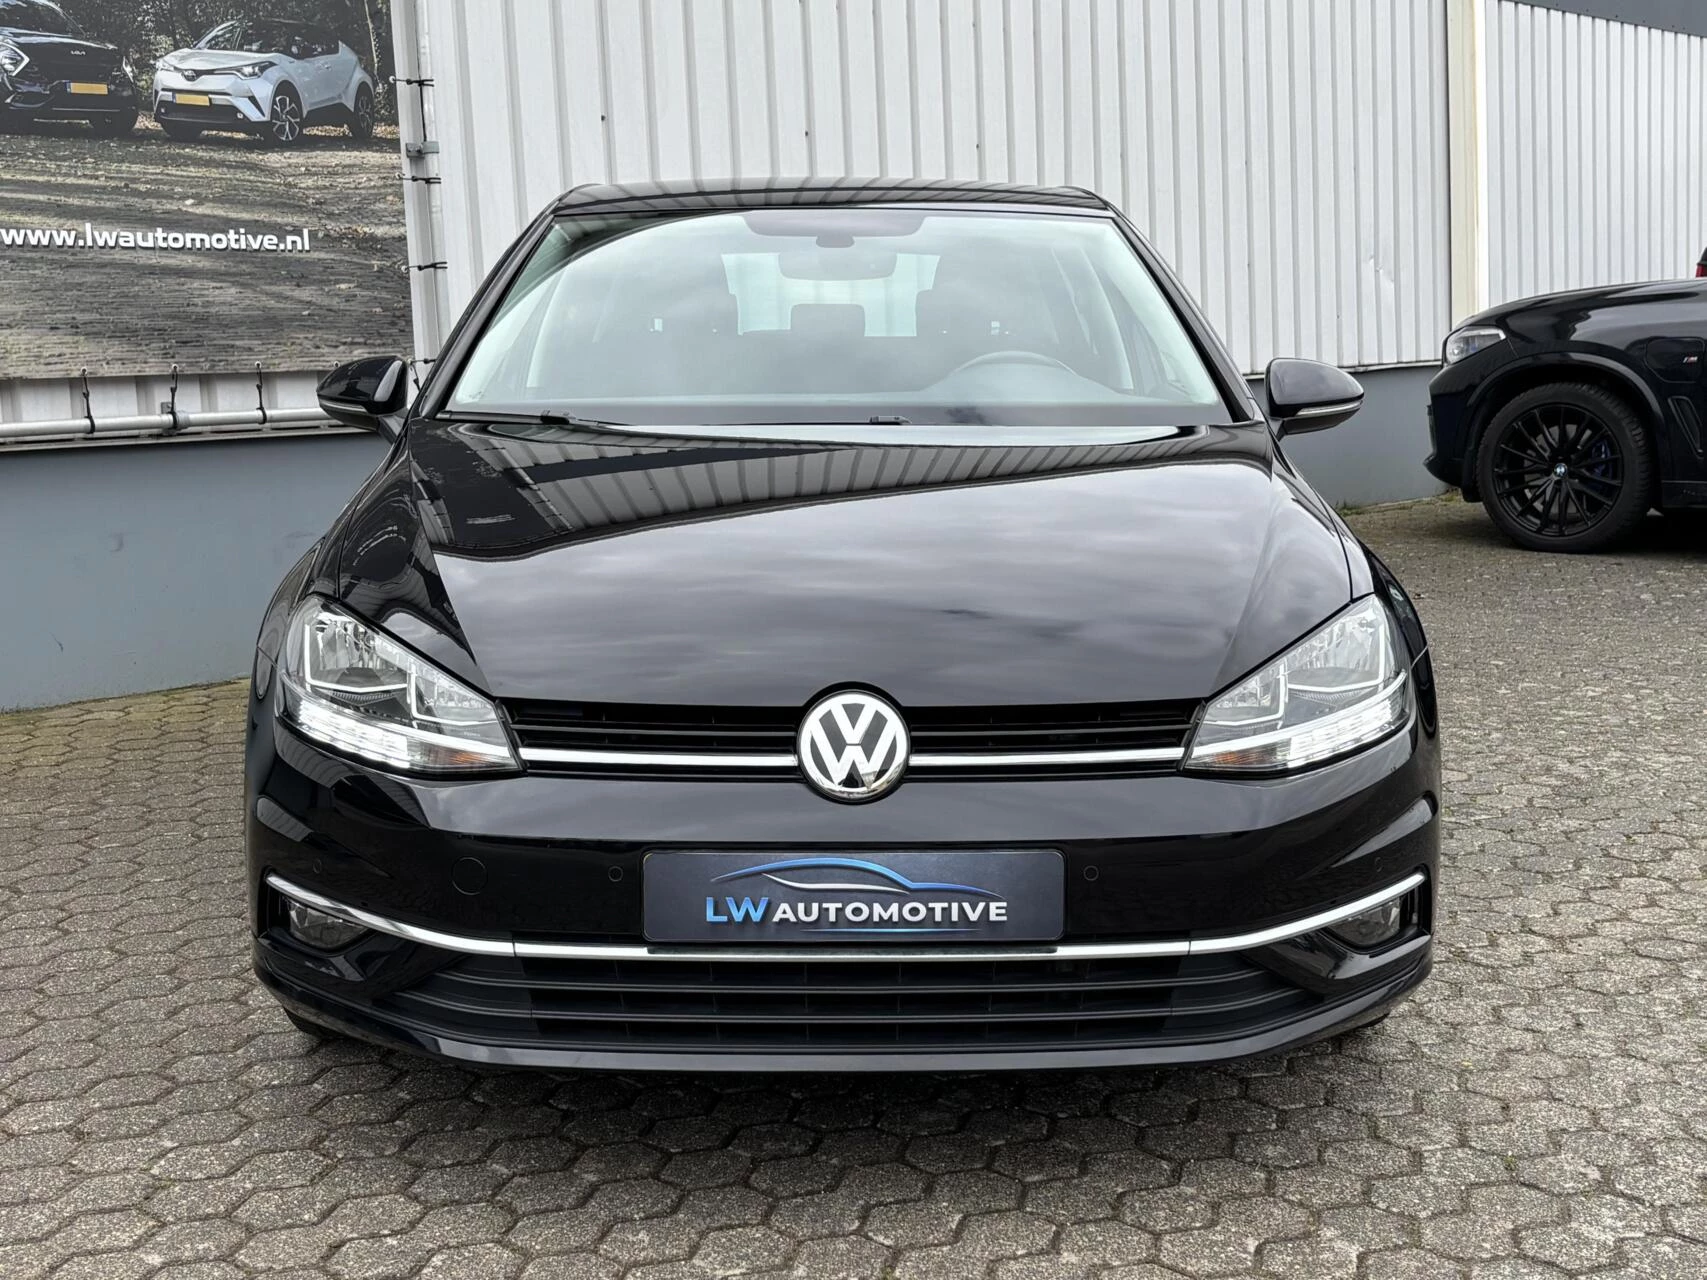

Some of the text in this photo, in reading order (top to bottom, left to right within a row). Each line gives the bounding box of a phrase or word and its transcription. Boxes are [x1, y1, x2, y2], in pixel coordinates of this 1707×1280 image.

[0, 222, 310, 251] www.lwautomotive.nl
[804, 697, 903, 791] VW
[706, 896, 1008, 922] LW AUTOMOTIVE
